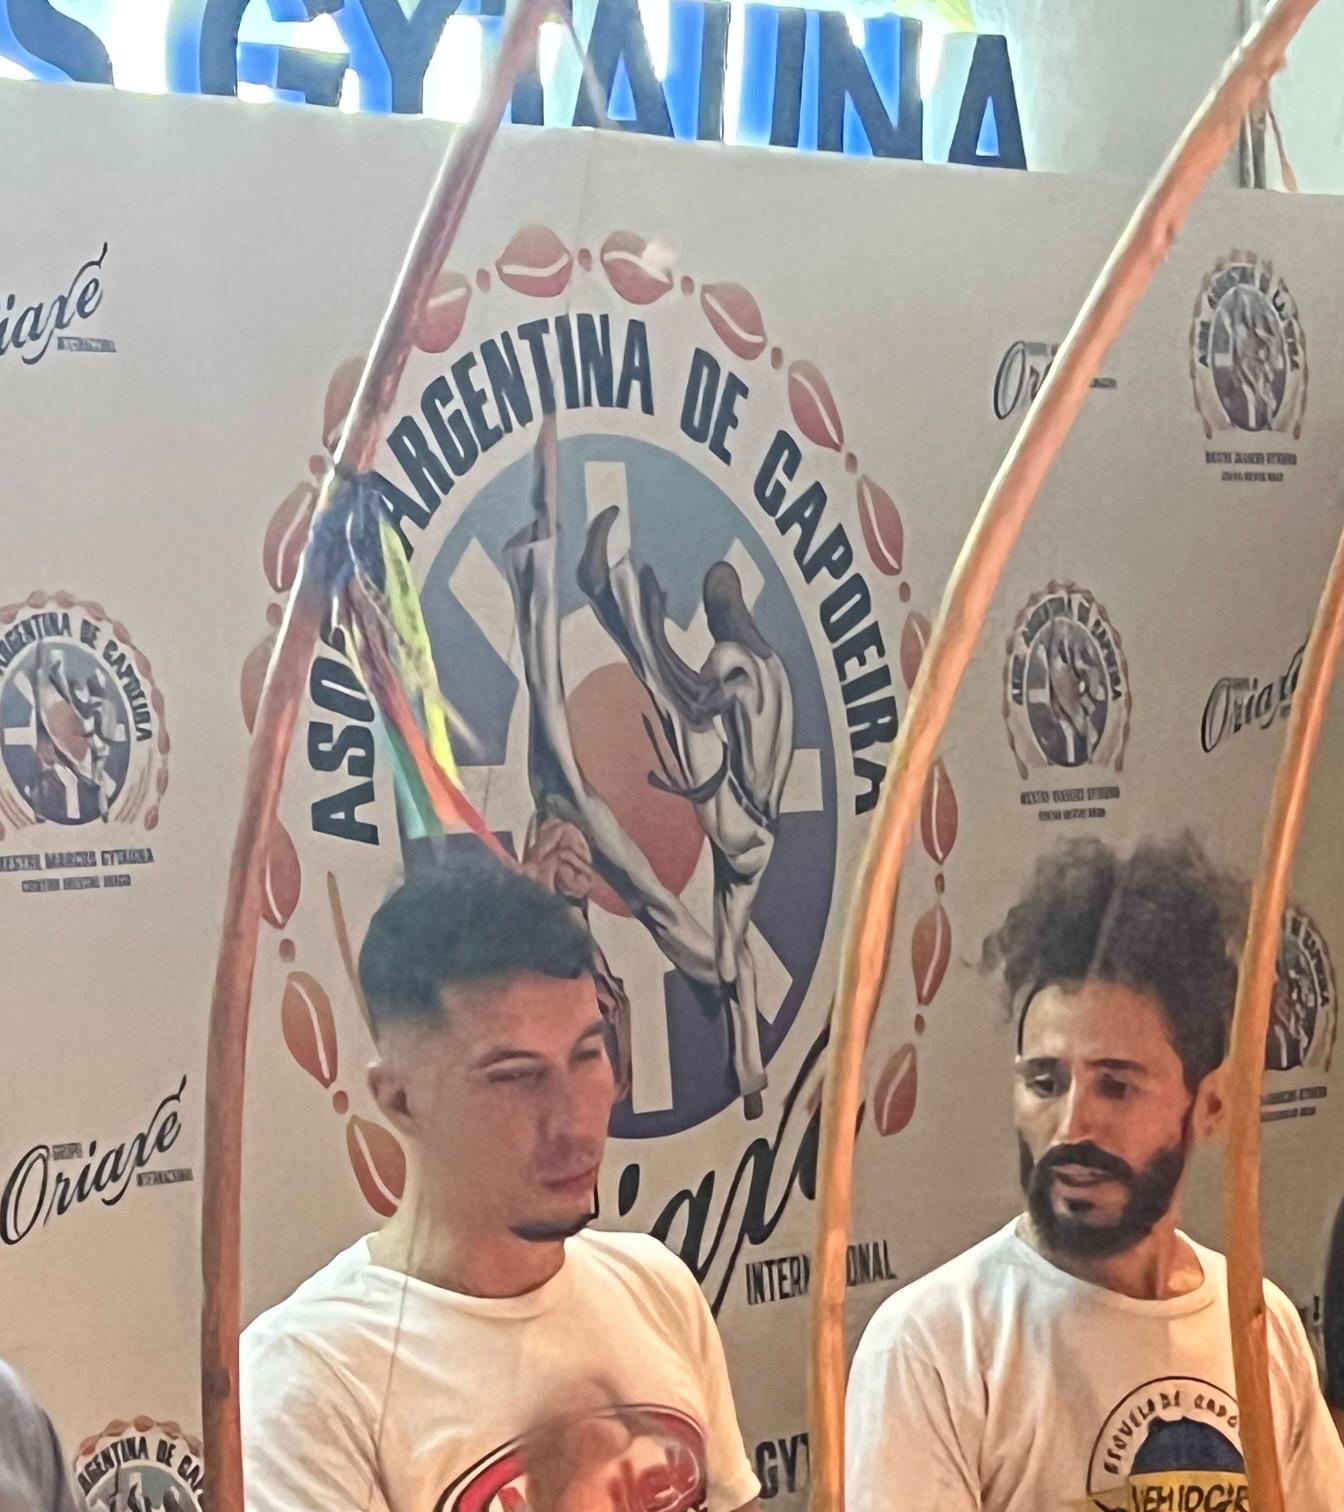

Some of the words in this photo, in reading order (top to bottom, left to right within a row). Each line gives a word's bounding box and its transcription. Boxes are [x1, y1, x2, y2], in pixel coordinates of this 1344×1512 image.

[368, 313, 655, 562] ARGENTINA
[679, 347, 750, 466] DE
[754, 429, 899, 816] CAPOEIRA
[745, 1239, 898, 1306] INTERONAL
